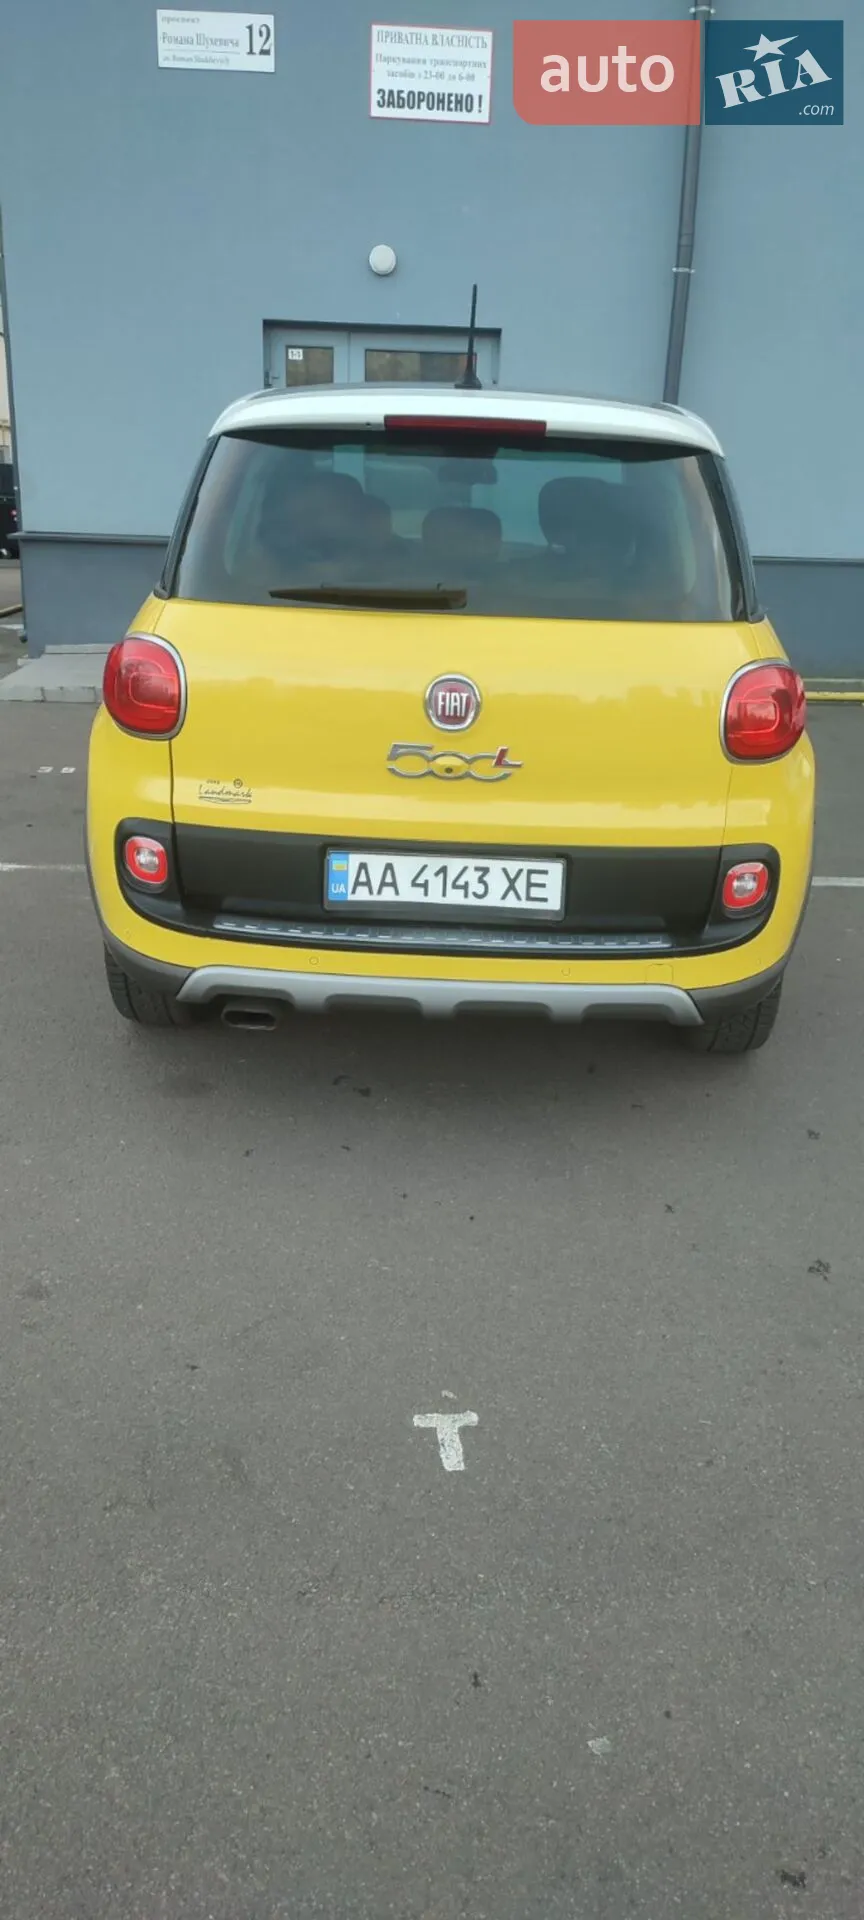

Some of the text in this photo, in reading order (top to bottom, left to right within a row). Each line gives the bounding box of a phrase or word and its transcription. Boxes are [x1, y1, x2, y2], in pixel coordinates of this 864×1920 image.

[162, 32, 240, 49] Романа Шухевича
[246, 23, 271, 56] 12
[376, 30, 488, 49] ПРИВАТНА ВЛАСНІСТЬ
[423, 70, 445, 80] 23-00
[376, 88, 483, 114] ЗАБОРОНЕНО !
[437, 692, 469, 717] FIAT
[331, 883, 346, 894] UA
[351, 862, 549, 902] AA 4143 XE
